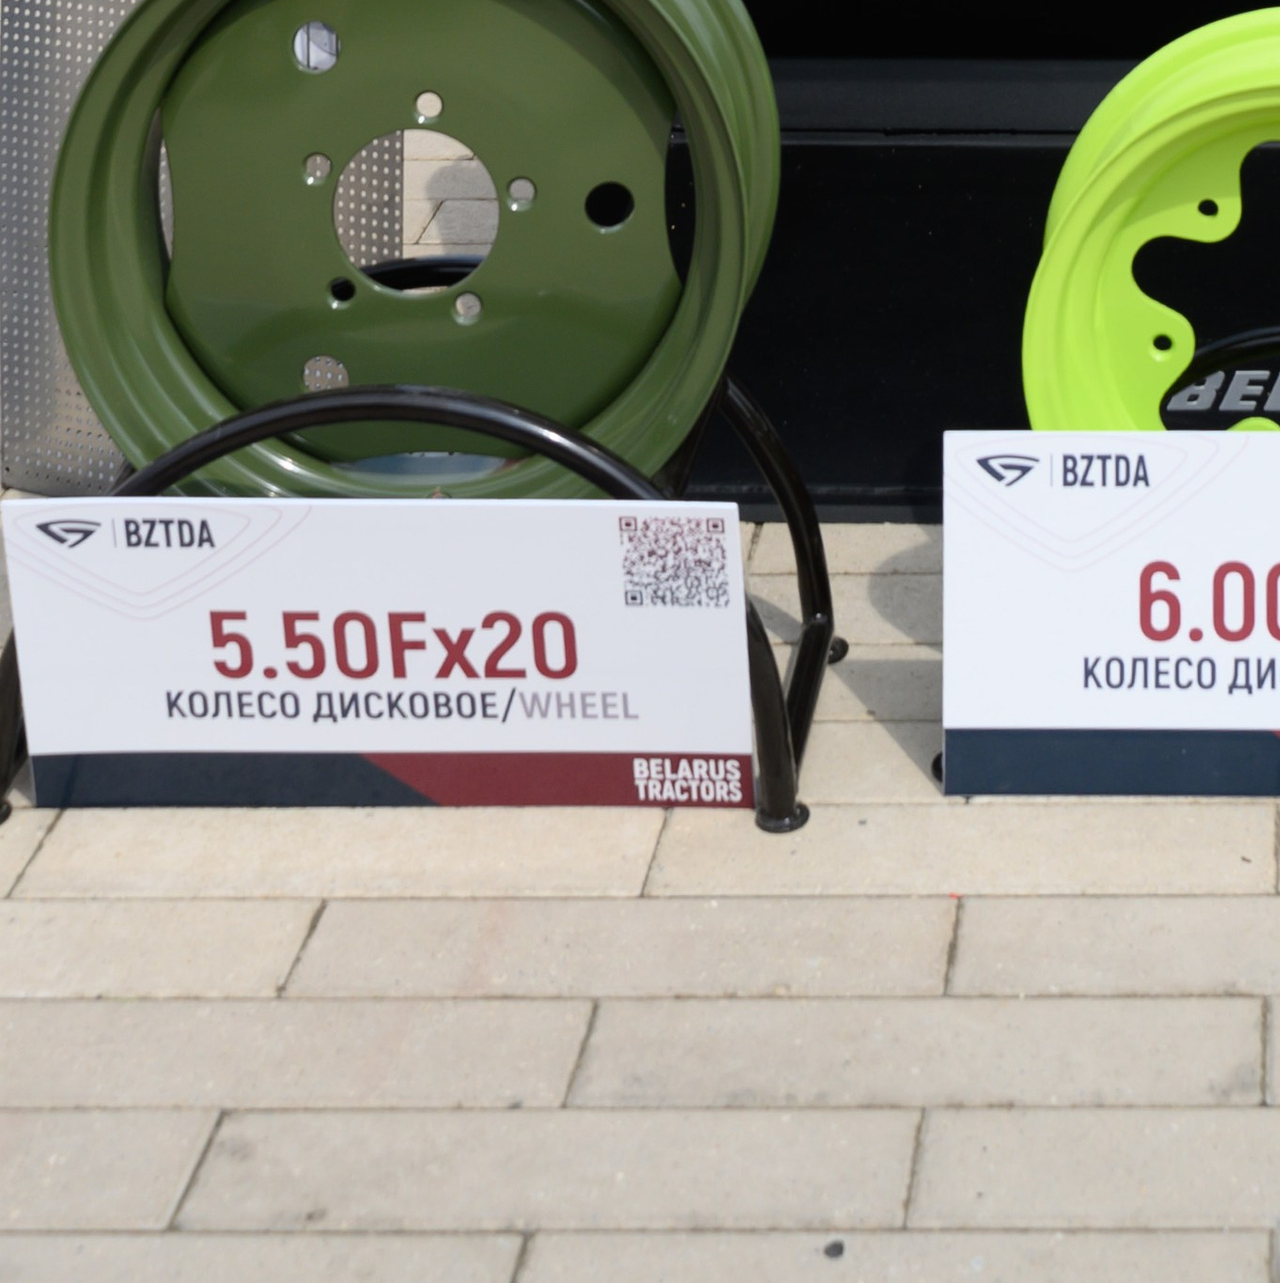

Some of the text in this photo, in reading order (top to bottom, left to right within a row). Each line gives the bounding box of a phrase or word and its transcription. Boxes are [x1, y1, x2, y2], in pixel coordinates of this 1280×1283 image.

[1061, 454, 1150, 489] BZTDA
[125, 518, 216, 550] BZTDA
[208, 610, 579, 681] 5.50Fx20
[1082, 656, 1217, 691] КОЛЕСО
[165, 686, 640, 724] КОЛЕСО ДИСКОВОЕ/WHEEL
[633, 757, 742, 783] BELARUS
[634, 779, 743, 803] TRACTORS
